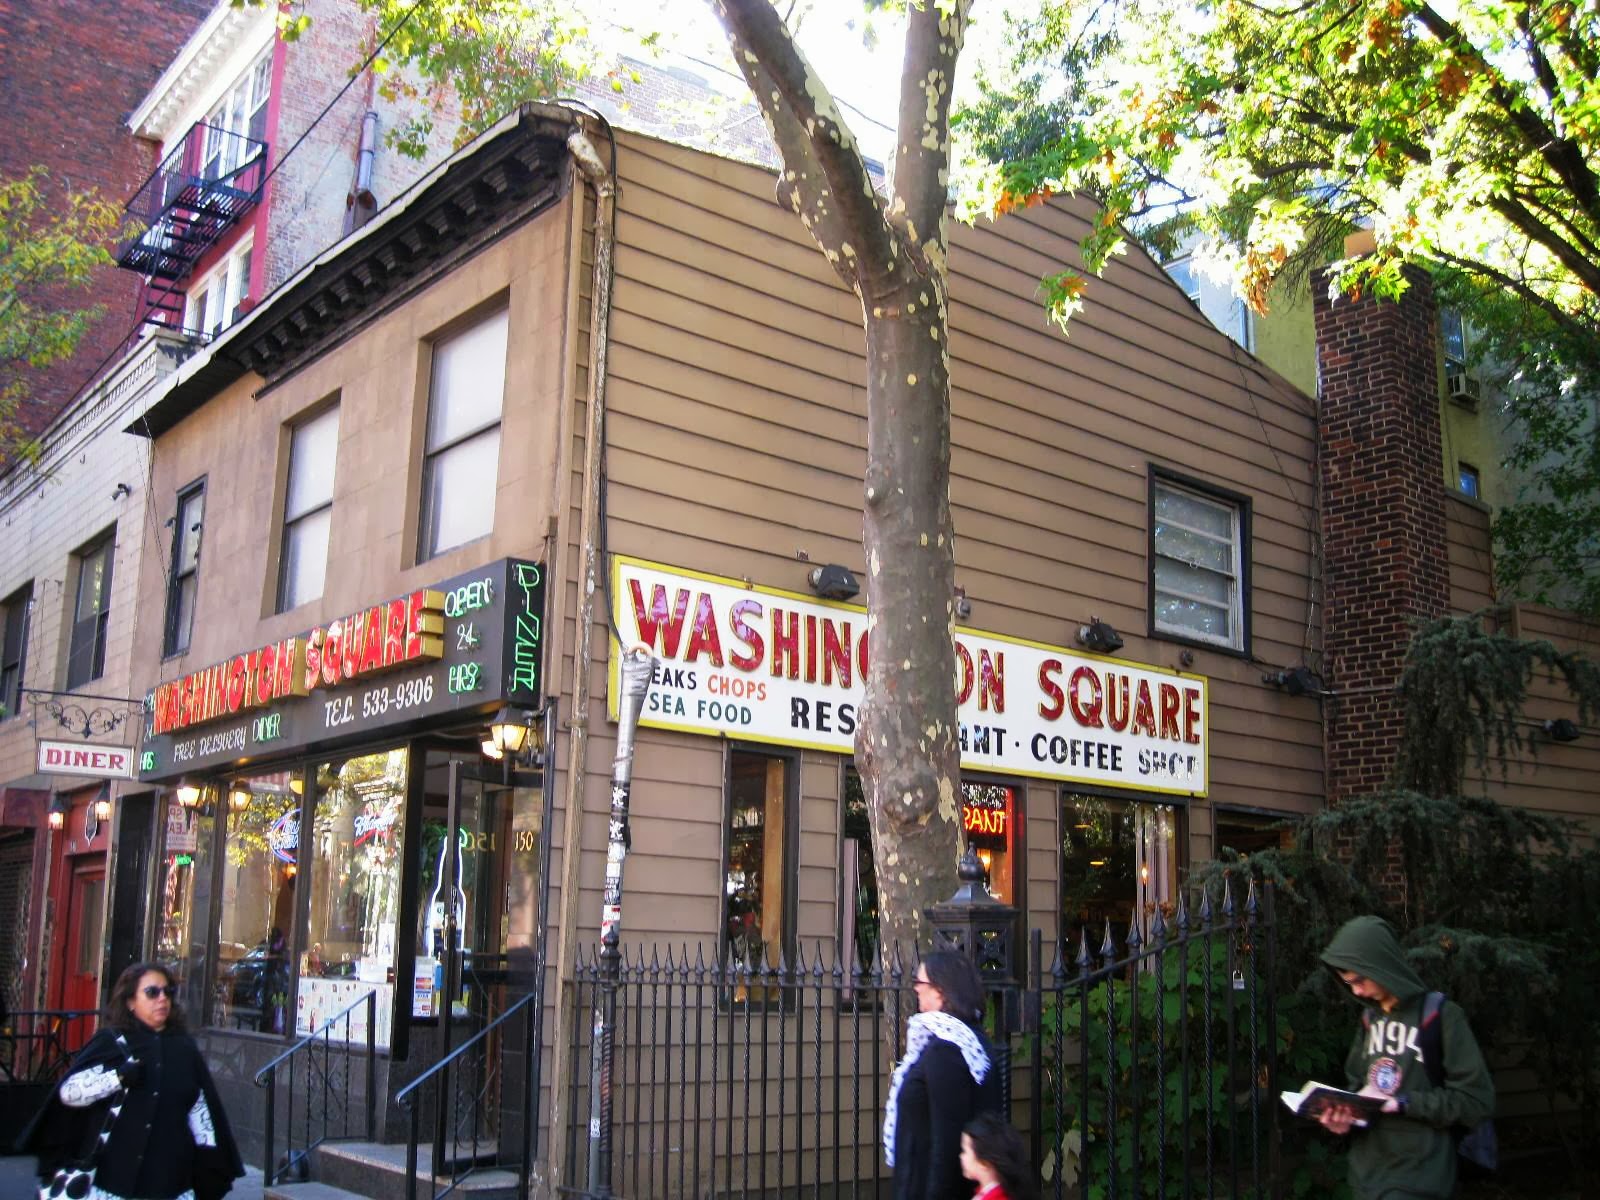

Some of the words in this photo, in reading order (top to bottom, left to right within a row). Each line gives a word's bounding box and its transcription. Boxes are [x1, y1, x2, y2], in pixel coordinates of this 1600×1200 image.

[444, 577, 492, 617] OPEN
[456, 621, 478, 651] 24
[513, 563, 540, 693] DINER
[153, 636, 296, 735] WASHINGTON
[304, 588, 444, 690] SQUARE
[448, 662, 479, 693] HRS
[626, 578, 1005, 713] WASHINON
[1037, 658, 1201, 745] SQUARE
[362, 675, 434, 718] 533-9306
[651, 665, 697, 690] EAKS
[707, 674, 767, 702] CHOPS
[649, 692, 686, 717] SEA
[697, 699, 752, 726] FOOD
[45, 748, 125, 770] DINER
[173, 739, 196, 763] FREE
[1031, 732, 1123, 773] COFFEE
[514, 831, 534, 852] 150
